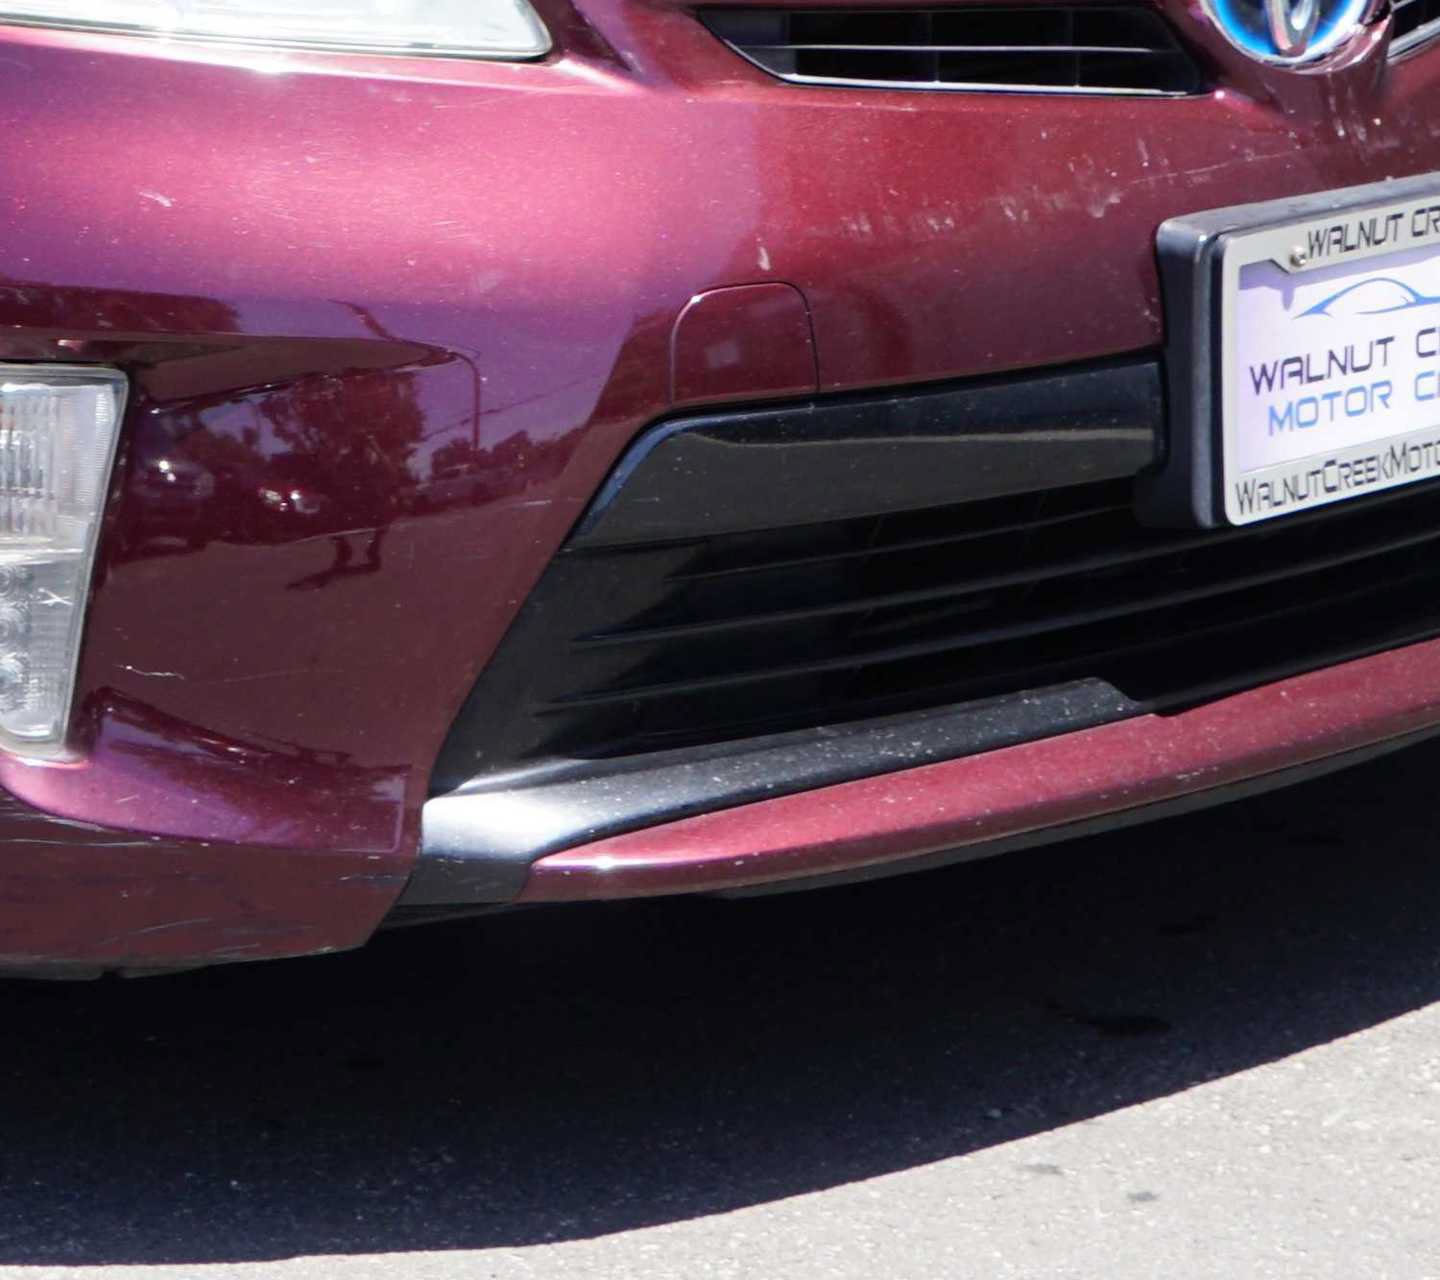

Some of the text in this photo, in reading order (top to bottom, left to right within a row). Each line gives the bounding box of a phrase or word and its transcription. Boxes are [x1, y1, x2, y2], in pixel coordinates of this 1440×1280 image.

[1306, 213, 1404, 257] WALNUT
[1249, 336, 1395, 396] WALNUT
[1267, 380, 1394, 437] MOTOR
